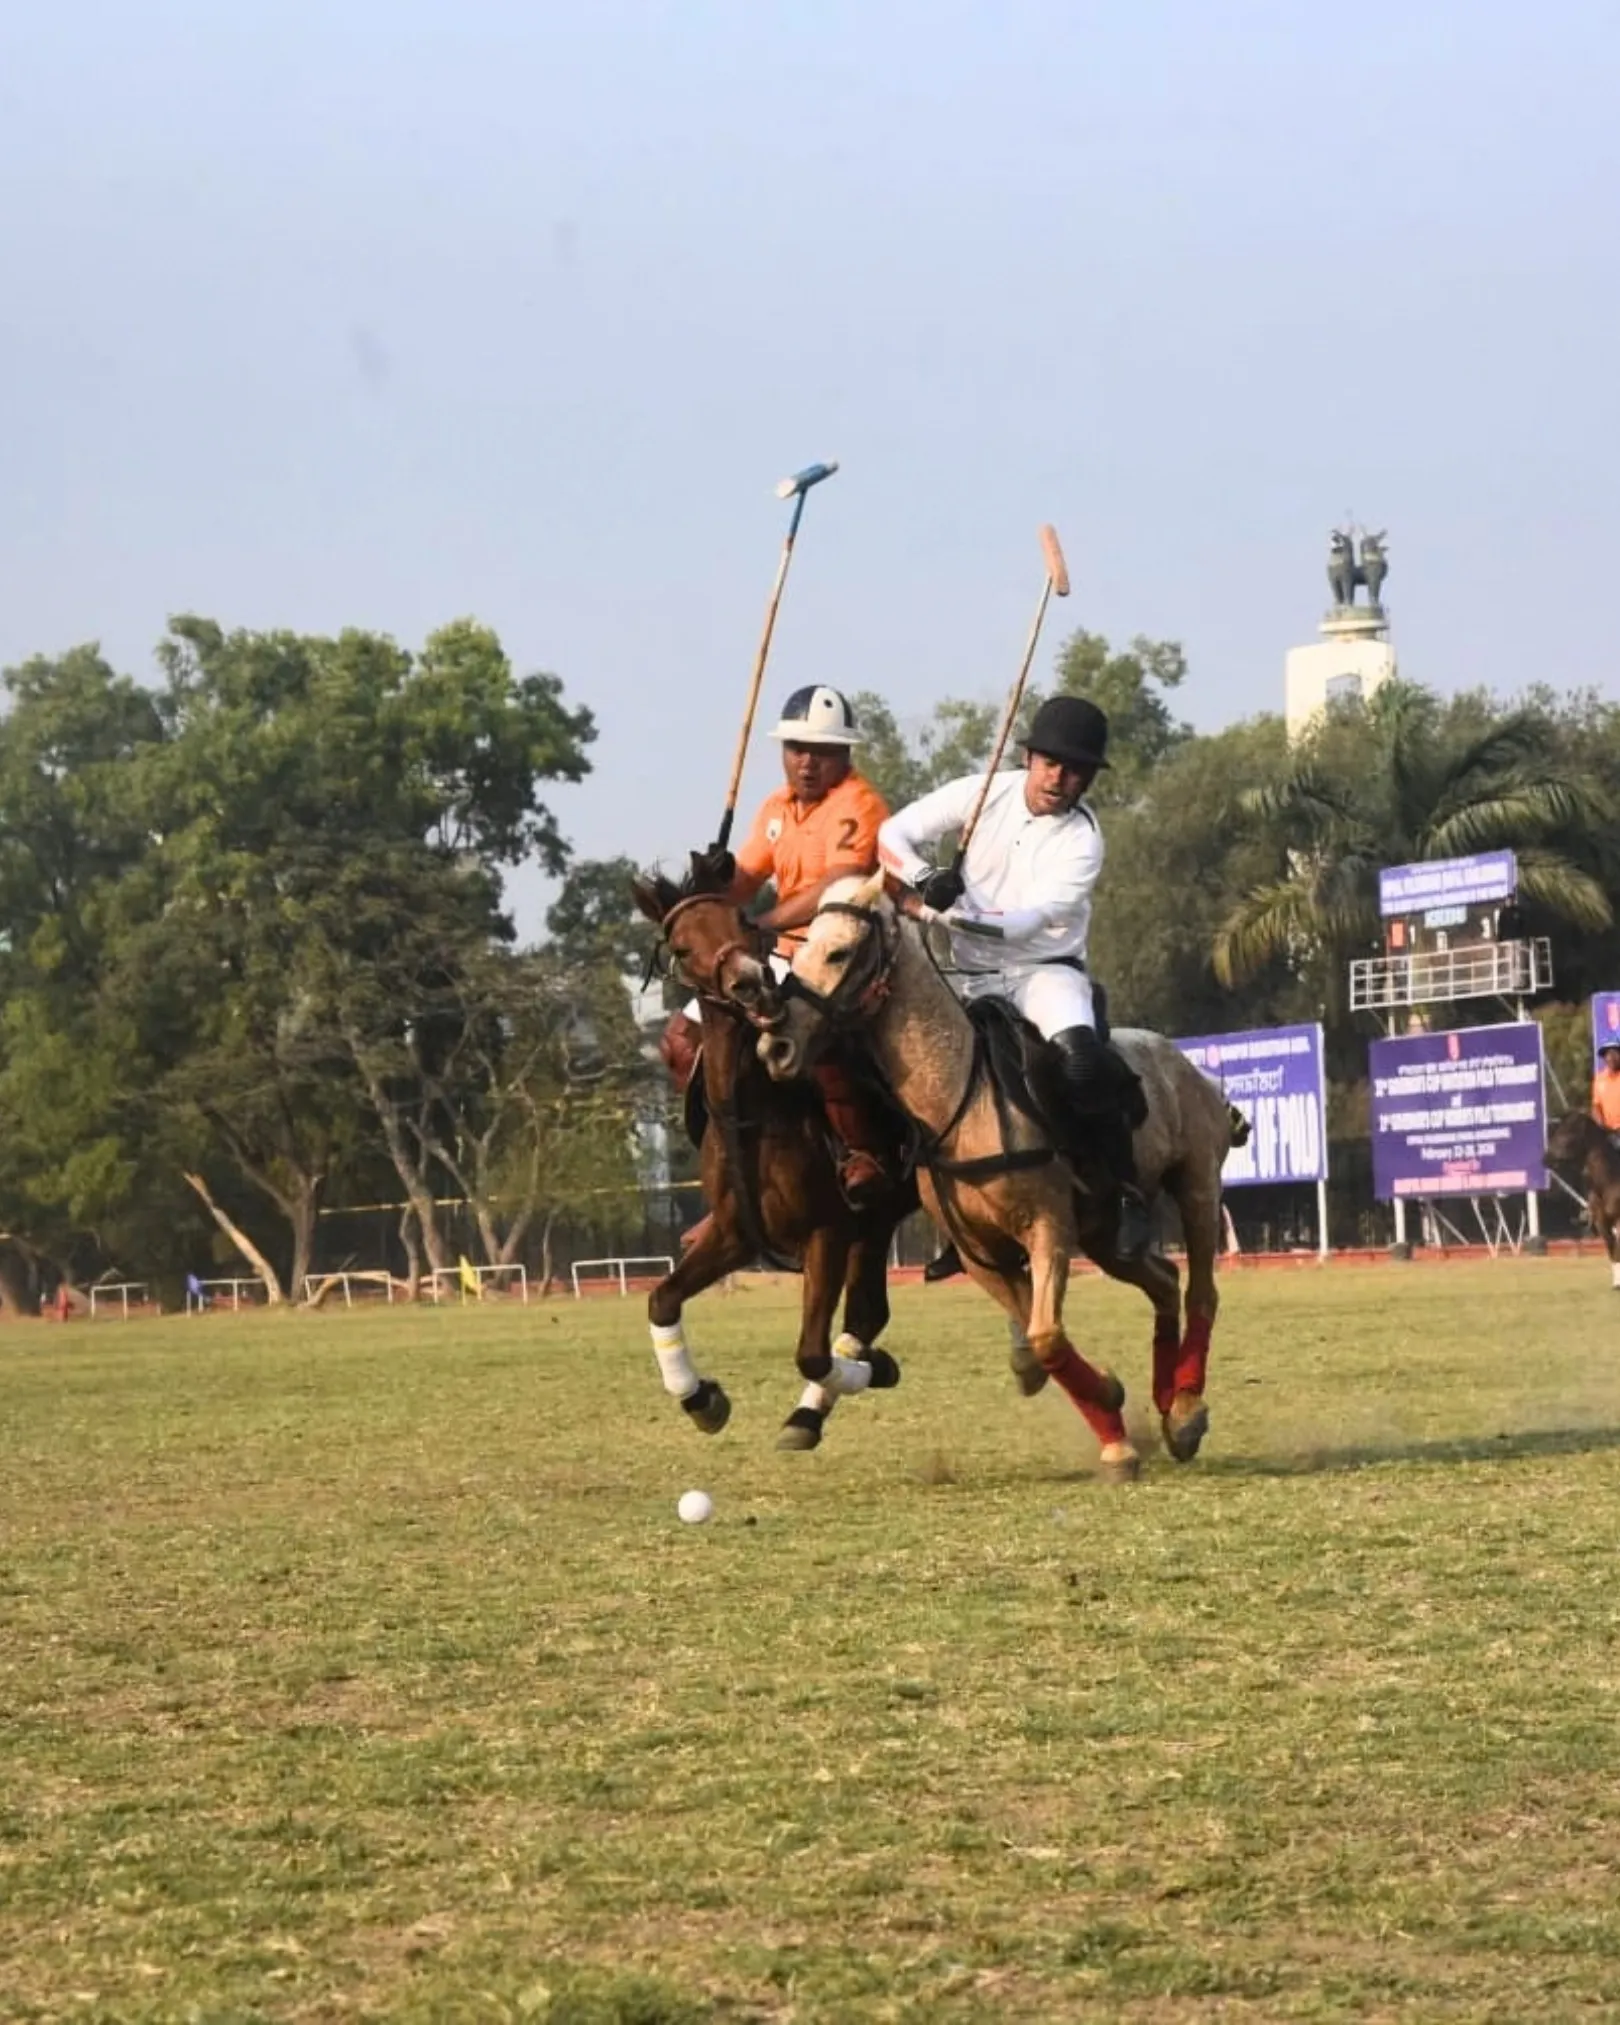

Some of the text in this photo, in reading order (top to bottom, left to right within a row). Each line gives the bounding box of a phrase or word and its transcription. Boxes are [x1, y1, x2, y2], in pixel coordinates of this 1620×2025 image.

[836, 818, 859, 851] 2
[1255, 1096, 1277, 1179] OF
[1277, 1091, 1320, 1177] POLO
